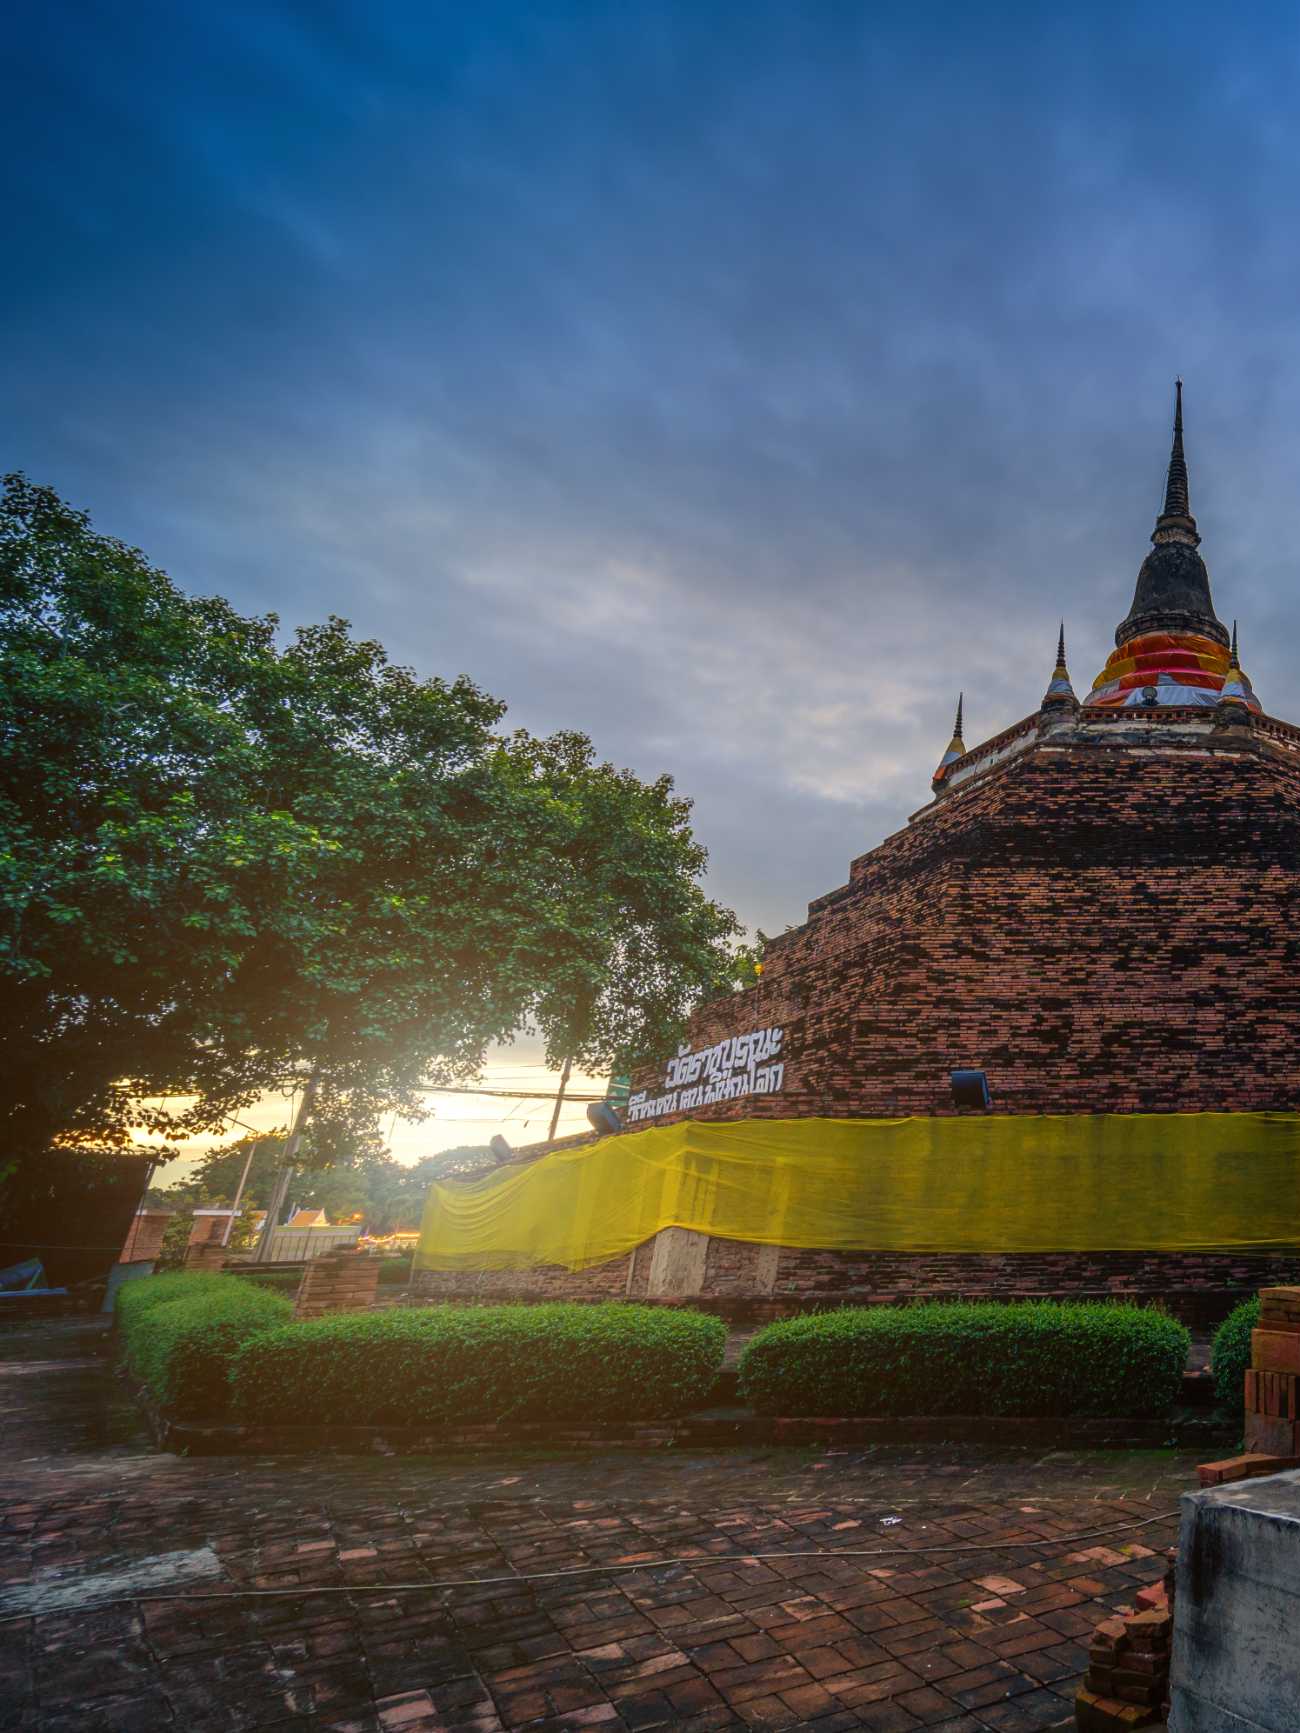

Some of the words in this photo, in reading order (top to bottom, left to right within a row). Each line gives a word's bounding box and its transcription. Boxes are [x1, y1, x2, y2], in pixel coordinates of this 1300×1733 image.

[665, 1028, 783, 1088] วัดราชบูรณะ
